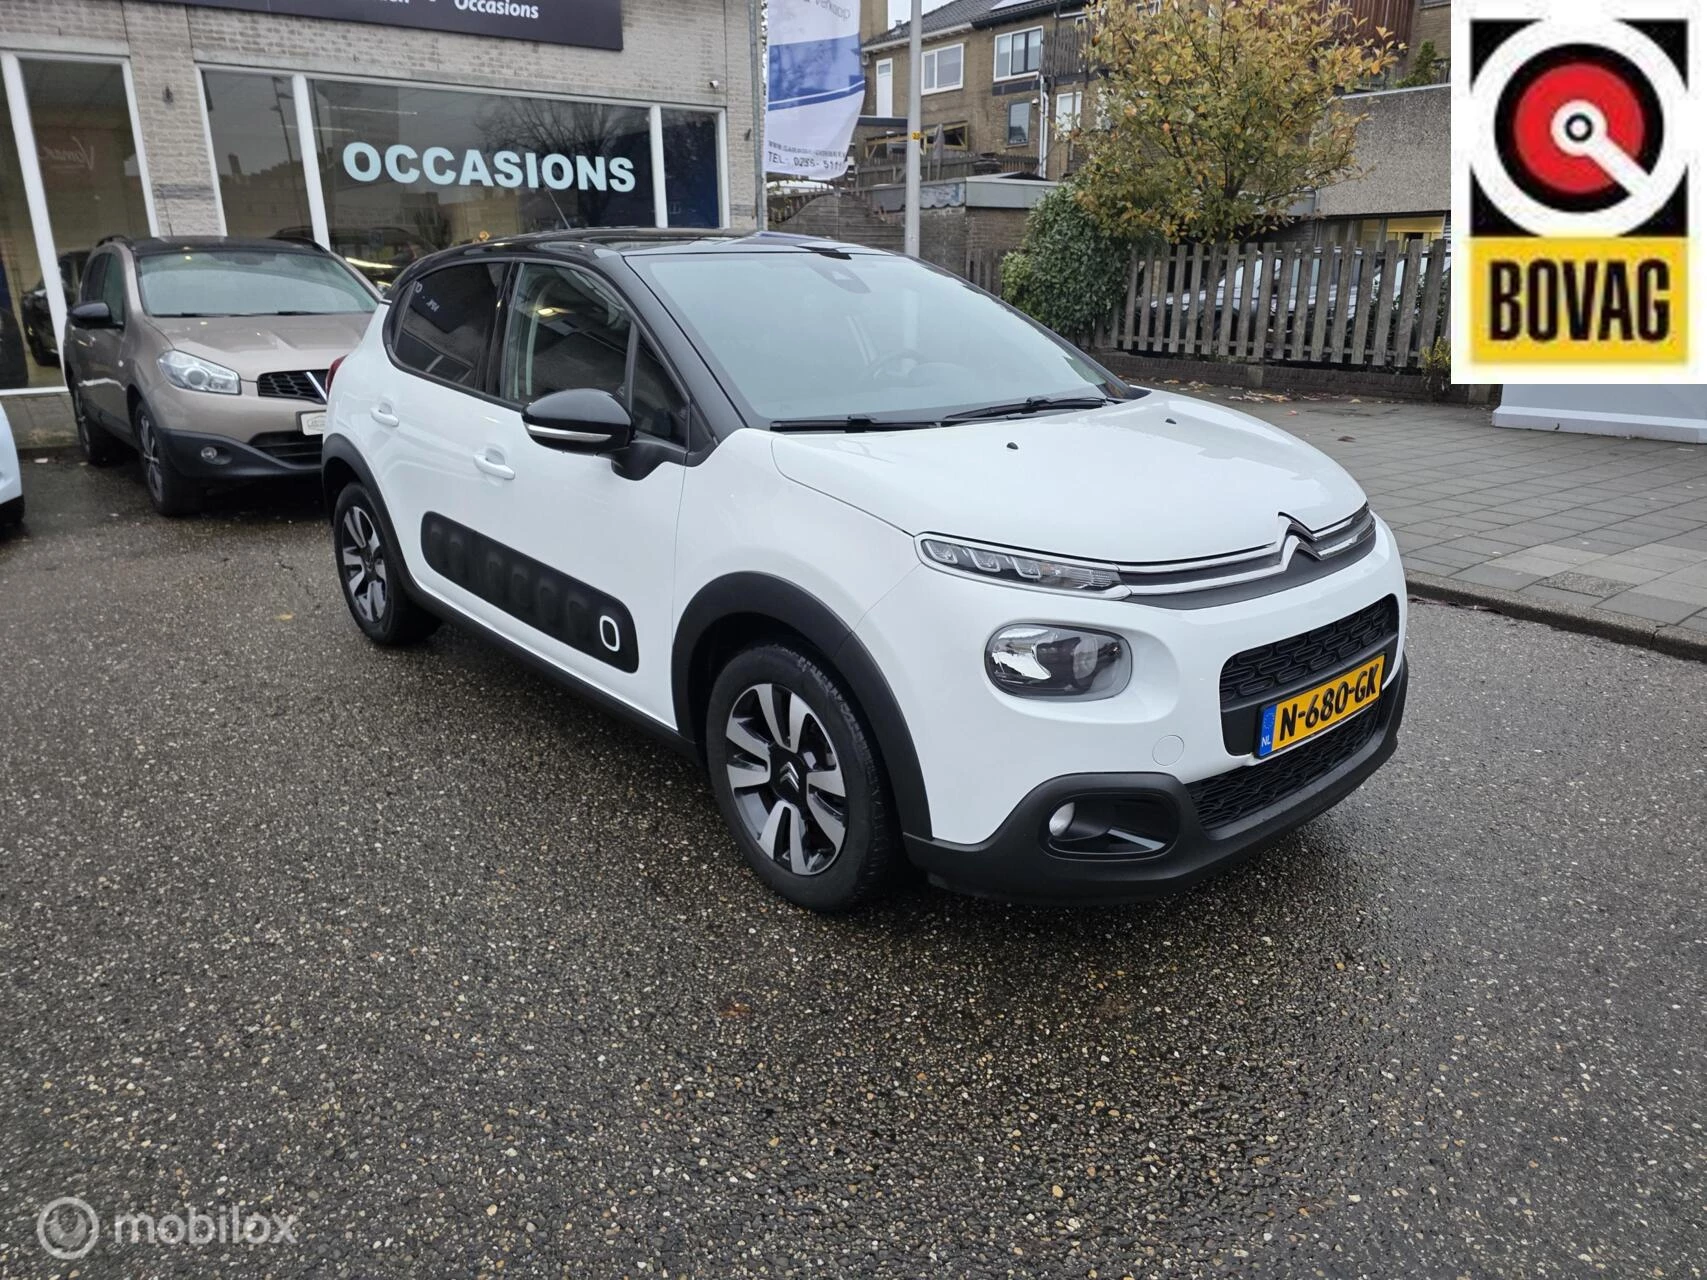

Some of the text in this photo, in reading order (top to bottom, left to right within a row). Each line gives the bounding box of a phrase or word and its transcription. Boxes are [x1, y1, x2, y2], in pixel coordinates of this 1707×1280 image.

[454, 0, 539, 19] Occasions
[342, 142, 635, 192] OCCASIONS
[1279, 663, 1379, 741] N-680-GK
